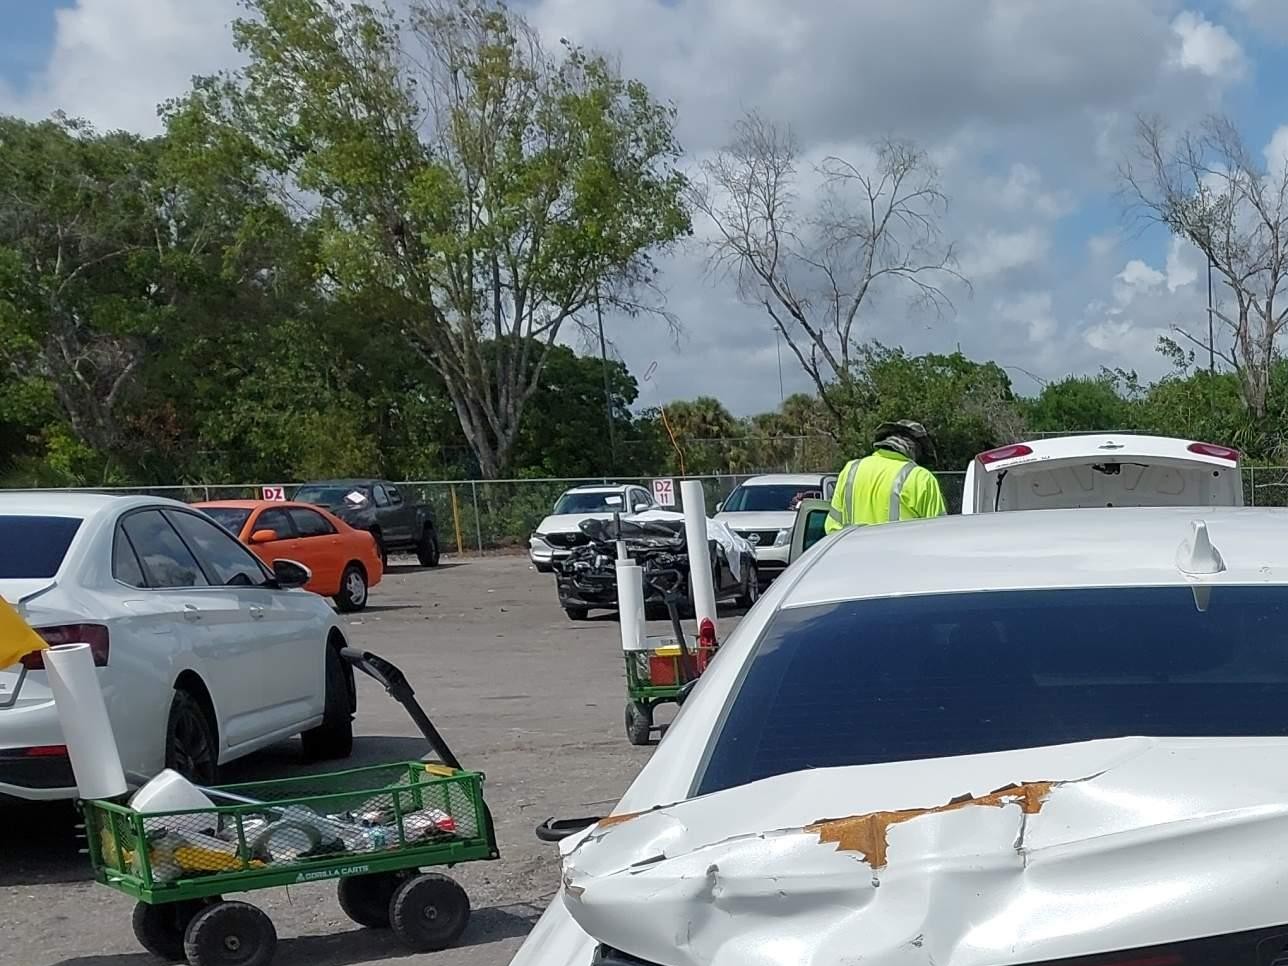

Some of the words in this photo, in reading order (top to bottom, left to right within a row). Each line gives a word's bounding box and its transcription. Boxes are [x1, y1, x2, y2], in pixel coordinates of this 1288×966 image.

[655, 481, 672, 492] DZ
[265, 489, 283, 500] DZ
[660, 493, 668, 504] 11
